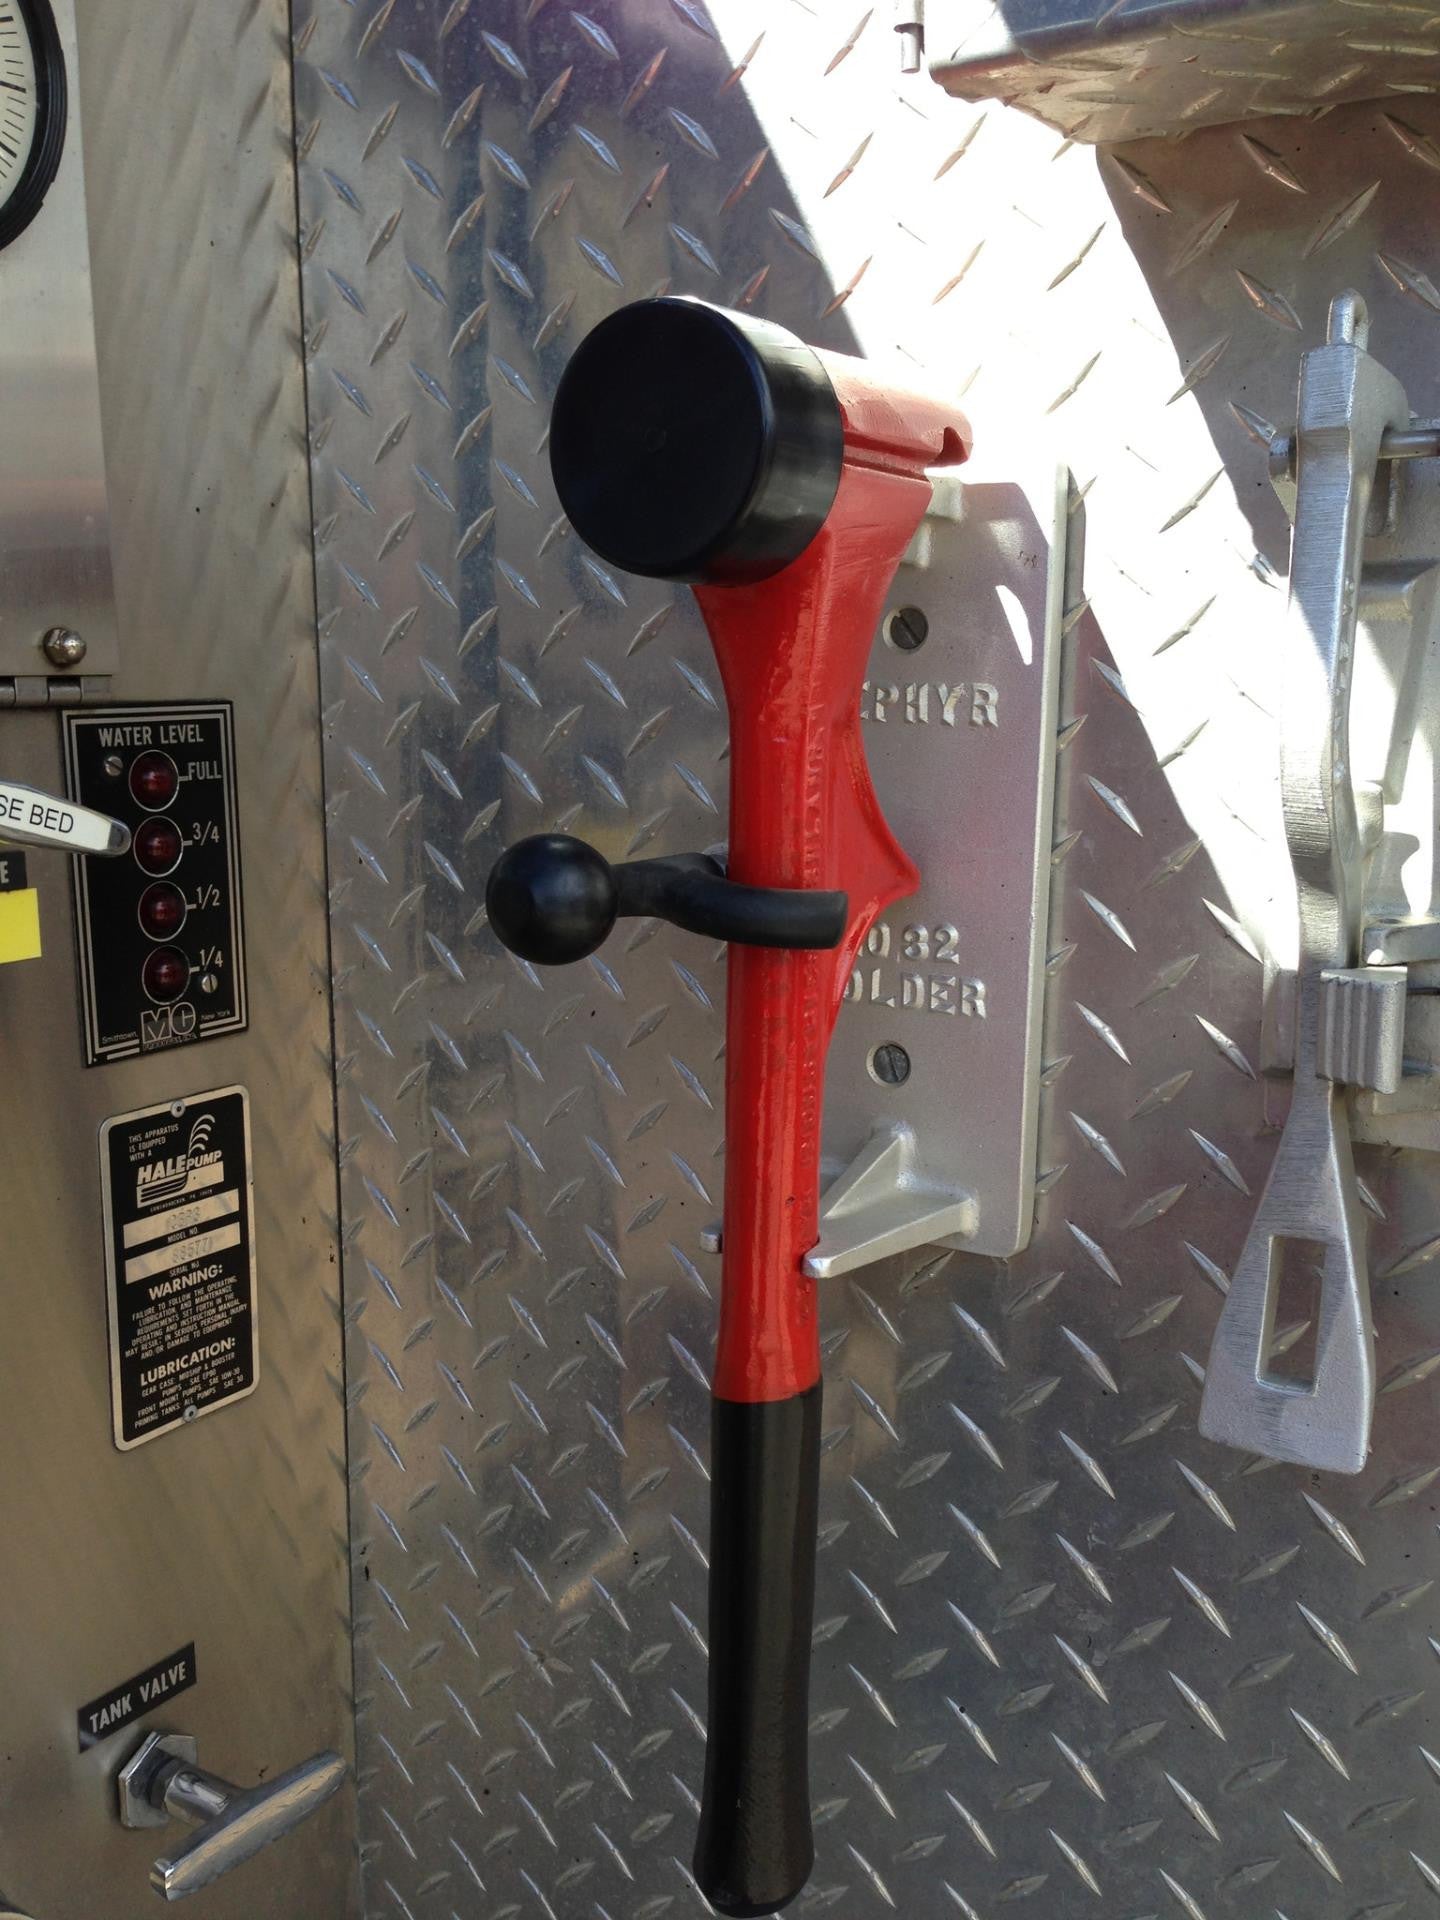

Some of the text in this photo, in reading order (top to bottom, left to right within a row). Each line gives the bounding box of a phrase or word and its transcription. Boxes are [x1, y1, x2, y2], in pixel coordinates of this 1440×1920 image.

[98, 724, 204, 747] WATER LEVEL
[187, 761, 221, 780] FULL
[30, 804, 74, 834] BED
[192, 821, 220, 846] 3/4
[196, 884, 220, 910] 1/2
[200, 945, 223, 972] 1/4
[129, 1123, 179, 1143] THIS APPARATUS
[129, 1136, 166, 1153] IS EQUIPPED
[130, 1152, 145, 1162] WITH
[138, 1150, 222, 1186] HALE PUMP
[168, 1232, 186, 1243] MODEL
[170, 1265, 188, 1278] SERIAL
[148, 1264, 223, 1300] WARNING:
[158, 1302, 166, 1310] TO
[194, 1287, 204, 1297] THE
[166, 1322, 178, 1333] AND
[193, 1330, 200, 1339] TO
[125, 1347, 138, 1358] MAY
[140, 1337, 236, 1386] LUBRICATION:
[190, 1376, 200, 1386] SAE
[208, 1376, 218, 1386] SAE
[224, 1380, 234, 1389] SAE
[142, 1385, 157, 1398] GEAR
[89, 1661, 187, 1733] TANK VALVE
